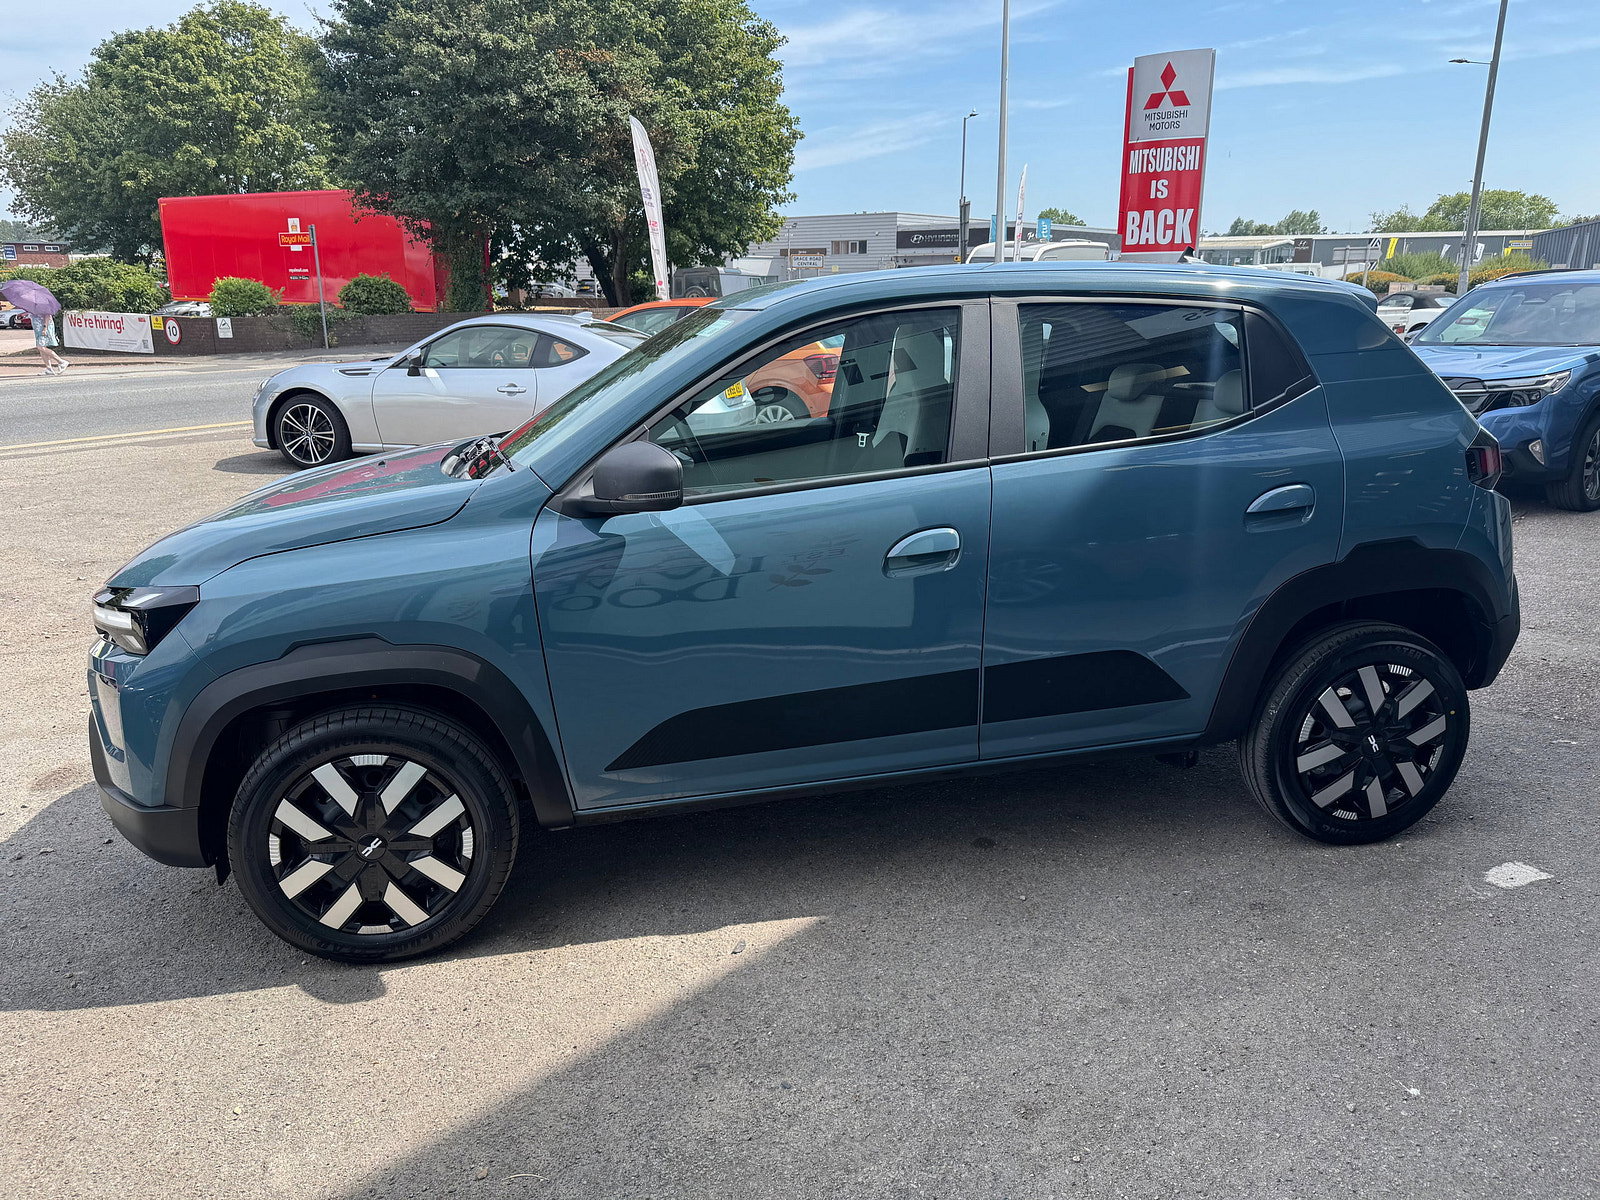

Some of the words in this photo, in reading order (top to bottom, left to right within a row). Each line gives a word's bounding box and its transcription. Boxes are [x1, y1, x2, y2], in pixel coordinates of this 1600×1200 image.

[1144, 110, 1188, 122] MITSUBISHI
[1149, 121, 1180, 131] MOTORS
[1129, 145, 1200, 175] MITSUBISHI
[1150, 179, 1169, 199] IS
[1125, 208, 1194, 246] BACK
[281, 235, 297, 244] Royal
[68, 315, 93, 328] We're
[94, 316, 124, 334] hiring!
[168, 326, 177, 337] 10
